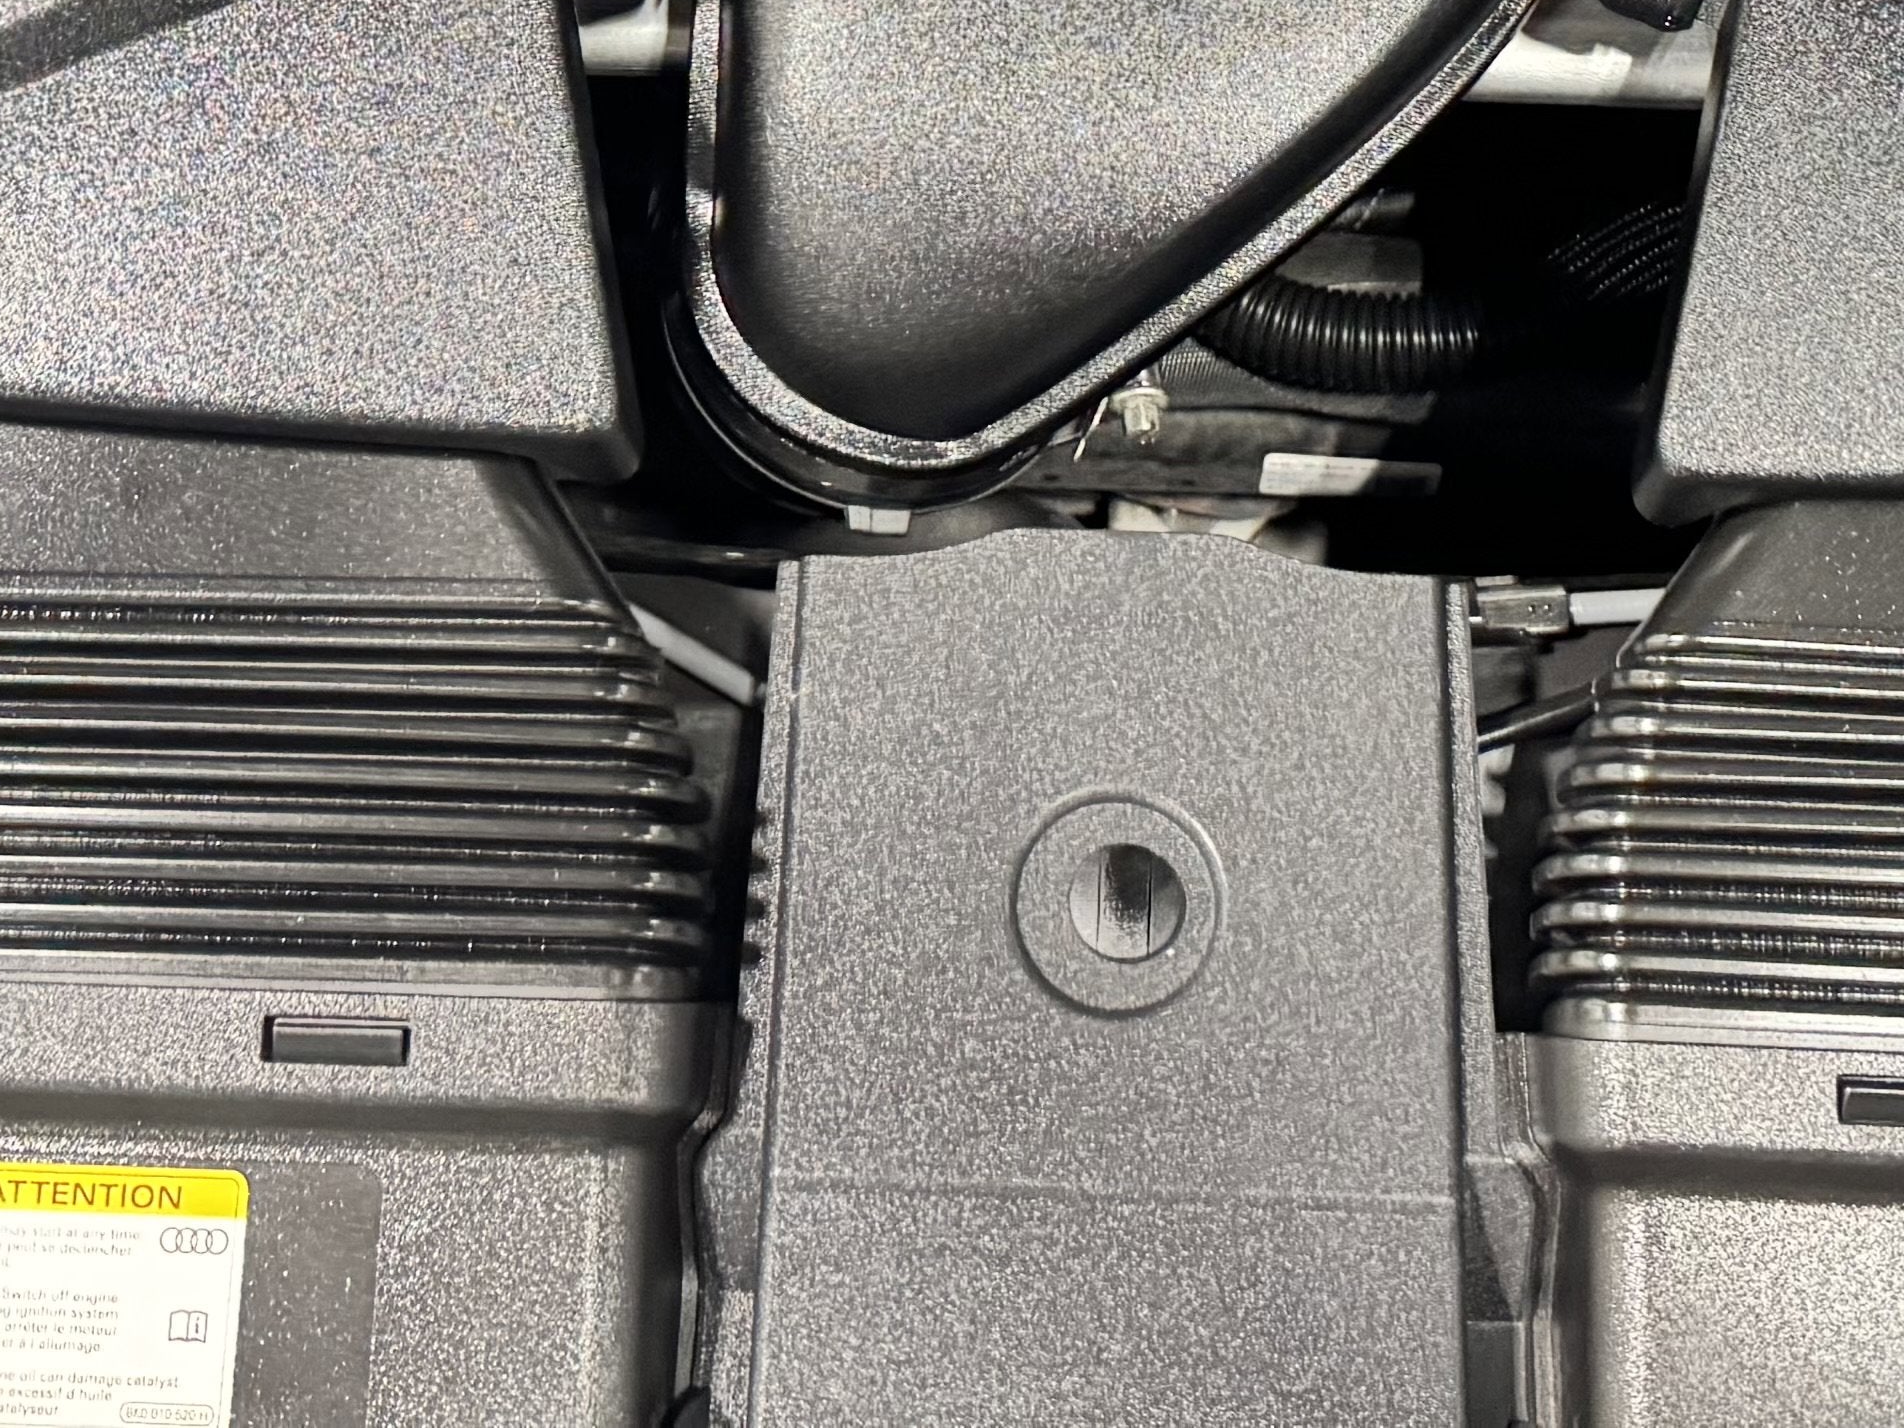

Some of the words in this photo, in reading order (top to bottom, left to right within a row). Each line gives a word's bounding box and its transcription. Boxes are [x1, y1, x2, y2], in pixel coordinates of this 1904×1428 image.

[19, 1367, 36, 1382] oil
[39, 1372, 65, 1384] can
[66, 1371, 123, 1387] damage
